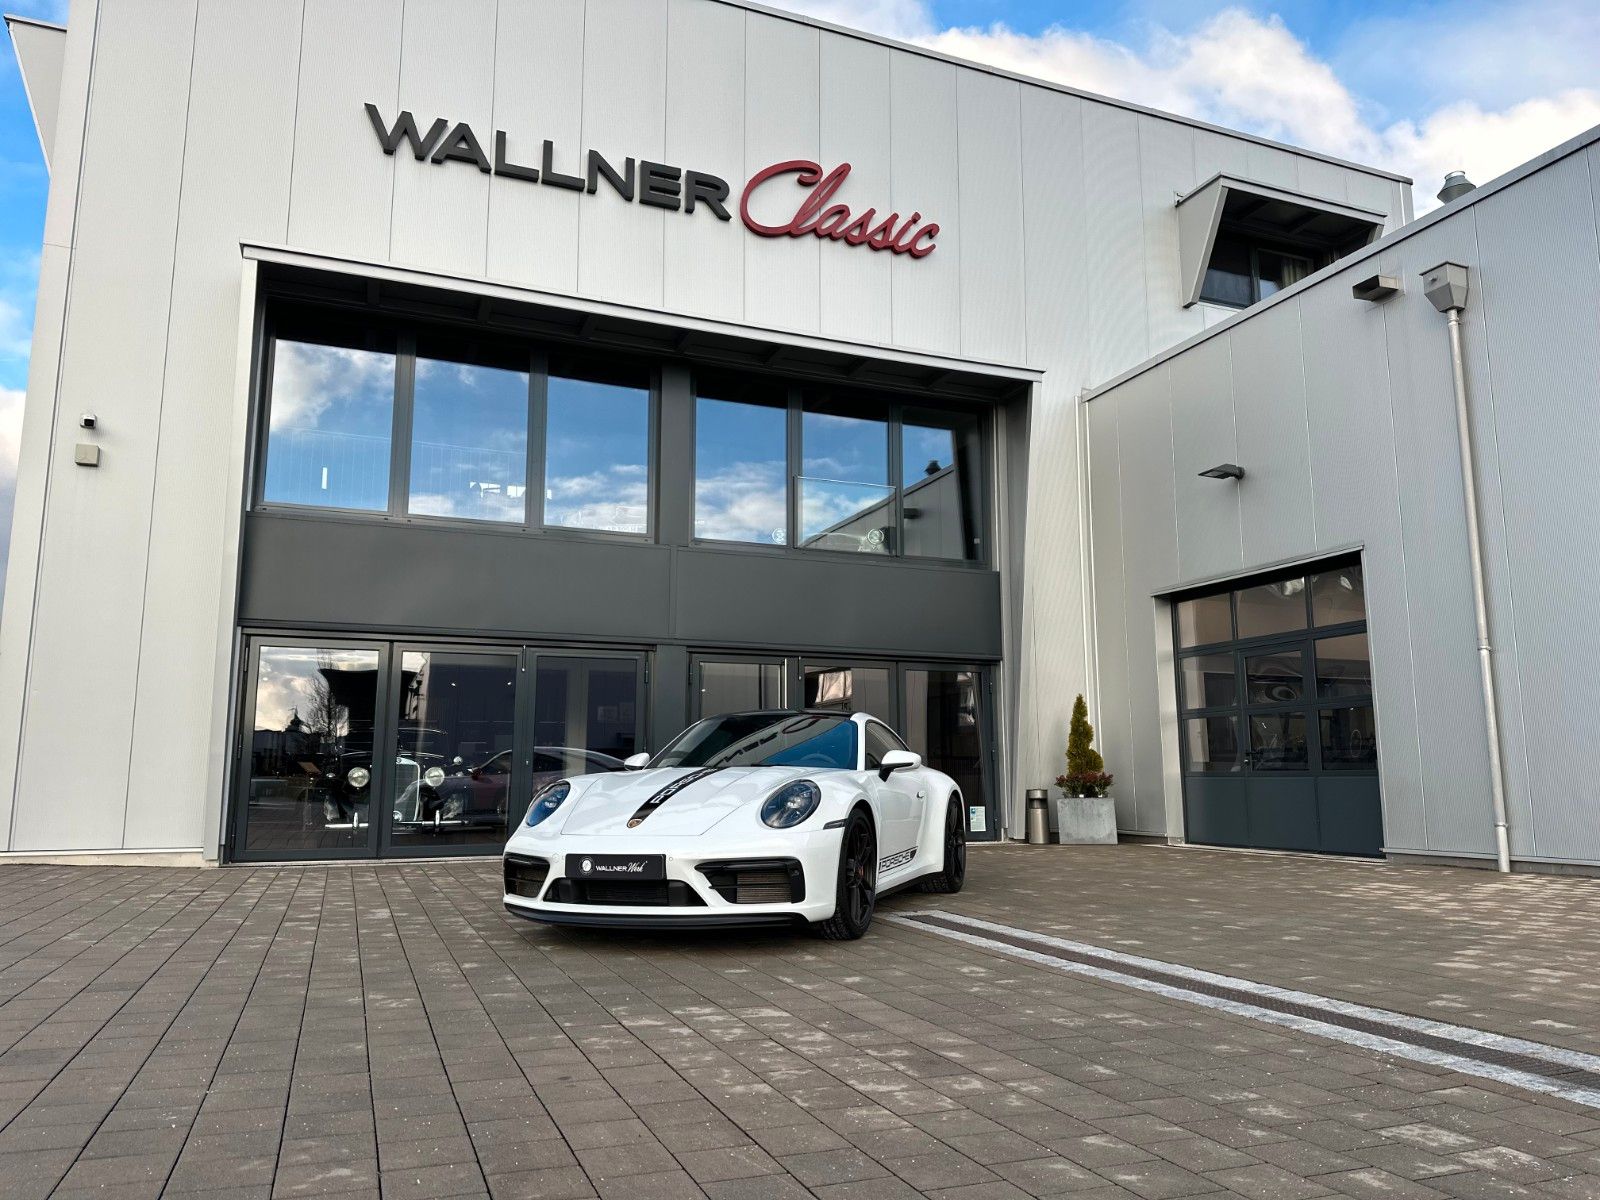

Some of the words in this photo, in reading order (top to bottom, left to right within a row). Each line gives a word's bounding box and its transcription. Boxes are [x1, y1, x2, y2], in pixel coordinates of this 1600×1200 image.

[364, 103, 732, 221] WALLNER
[740, 160, 941, 259] Classic
[626, 861, 646, 873] Werk
[880, 850, 911, 870] PORSCHE
